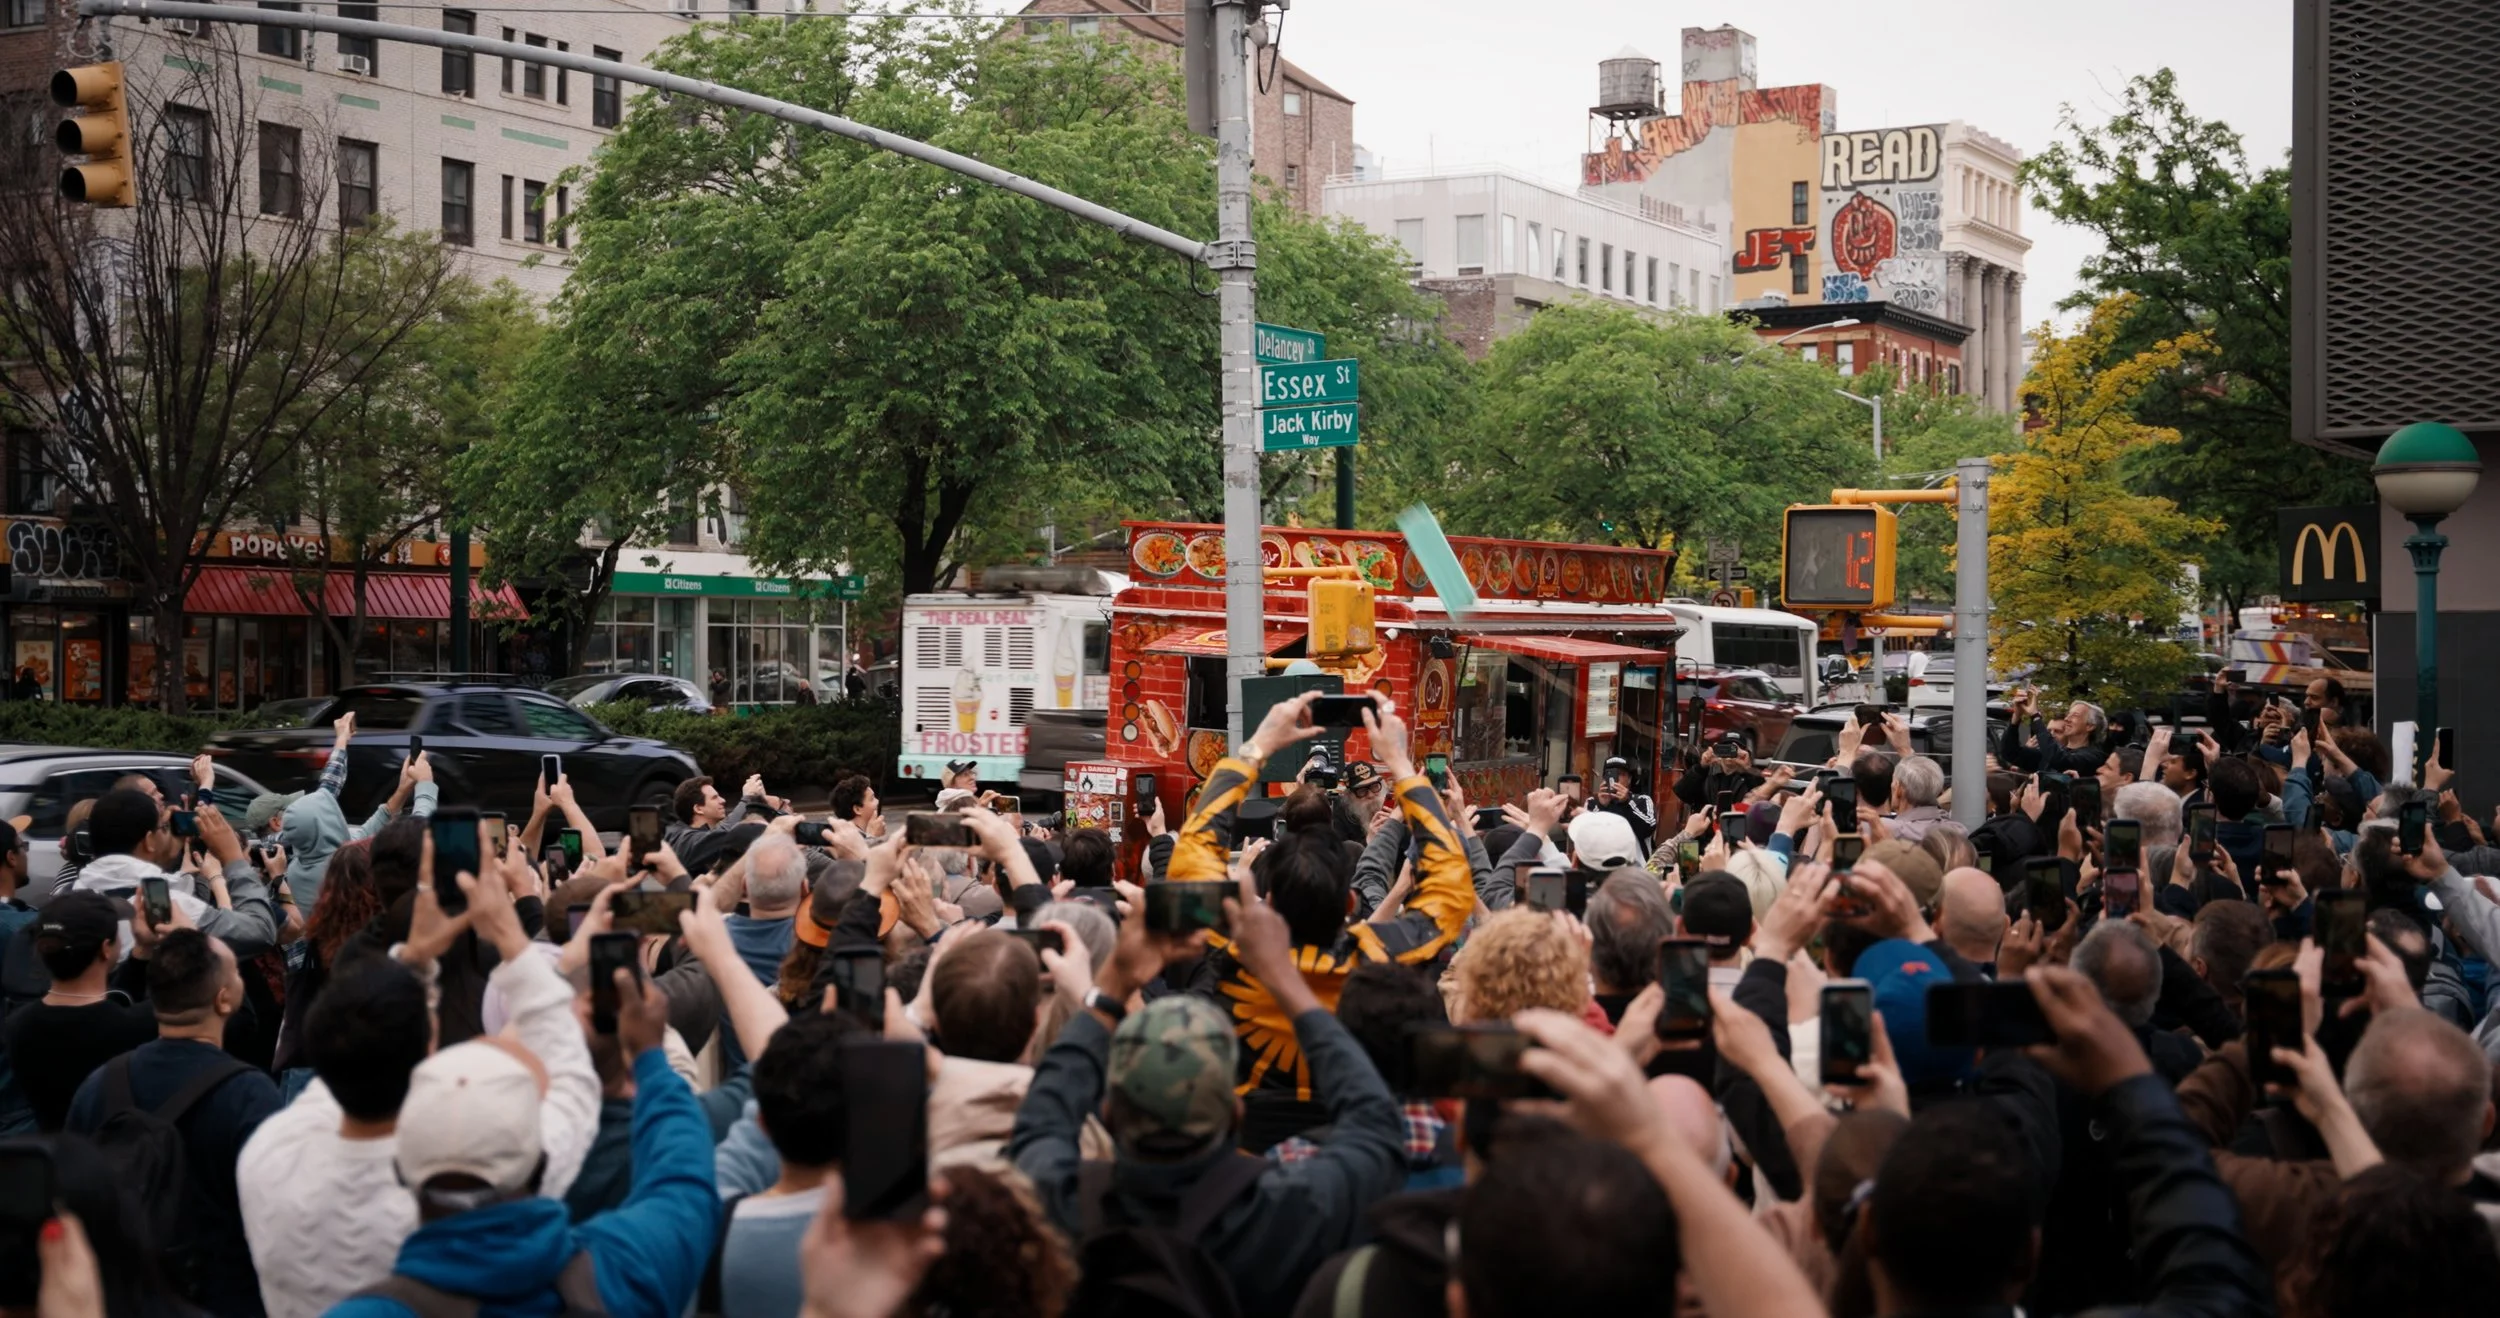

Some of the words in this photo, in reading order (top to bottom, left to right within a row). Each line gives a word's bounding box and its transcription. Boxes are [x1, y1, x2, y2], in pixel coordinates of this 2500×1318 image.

[1821, 126, 1940, 190] READ
[1733, 226, 1816, 274] JET
[1258, 329, 1304, 363] Delancey
[1307, 338, 1316, 355] St
[1264, 371, 1327, 401] Essex
[1336, 366, 1350, 385] St
[1268, 413, 1306, 434] Jack
[1311, 410, 1354, 434] Kirby
[1302, 434, 1320, 446] Way
[1846, 531, 1874, 590] 12
[672, 578, 702, 590] Citizens
[762, 581, 790, 593] Citizens
[957, 611, 989, 626] REAL
[921, 732, 1030, 755] FROSTEE
[1088, 766, 1117, 774] DANGER
